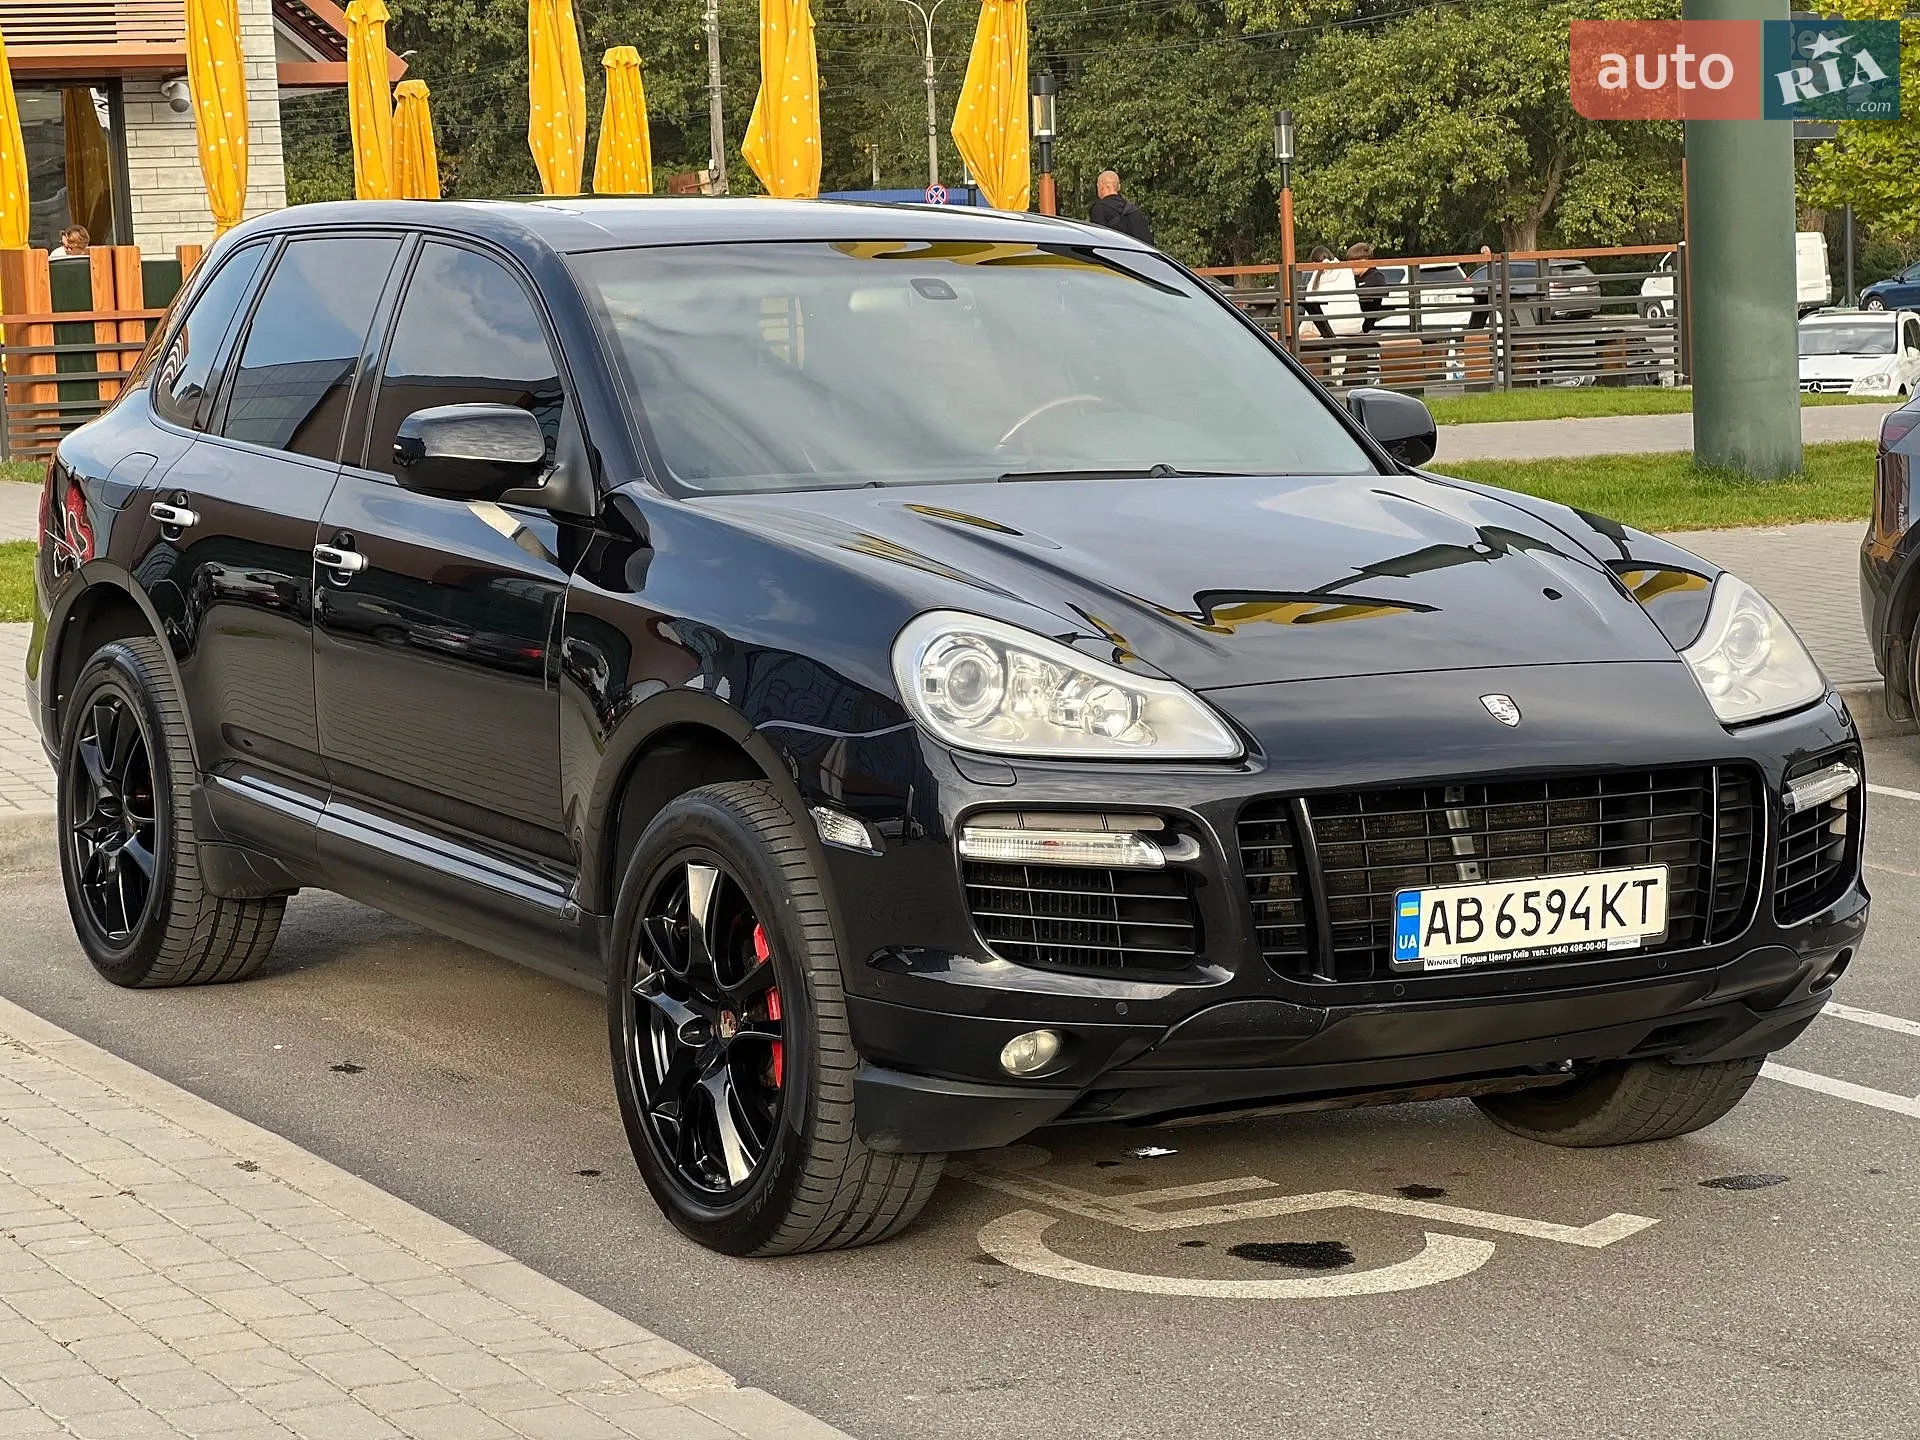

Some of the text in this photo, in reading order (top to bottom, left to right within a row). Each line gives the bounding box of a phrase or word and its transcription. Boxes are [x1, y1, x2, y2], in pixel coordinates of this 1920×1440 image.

[1423, 878, 1658, 947] AB 6594 KT
[1399, 934, 1417, 950] UA
[1426, 957, 1459, 967] WINNER
[1462, 954, 1487, 966] Порше
[1489, 952, 1511, 963] Центр
[1513, 949, 1529, 959] Київ
[1550, 945, 1569, 955] (044)
